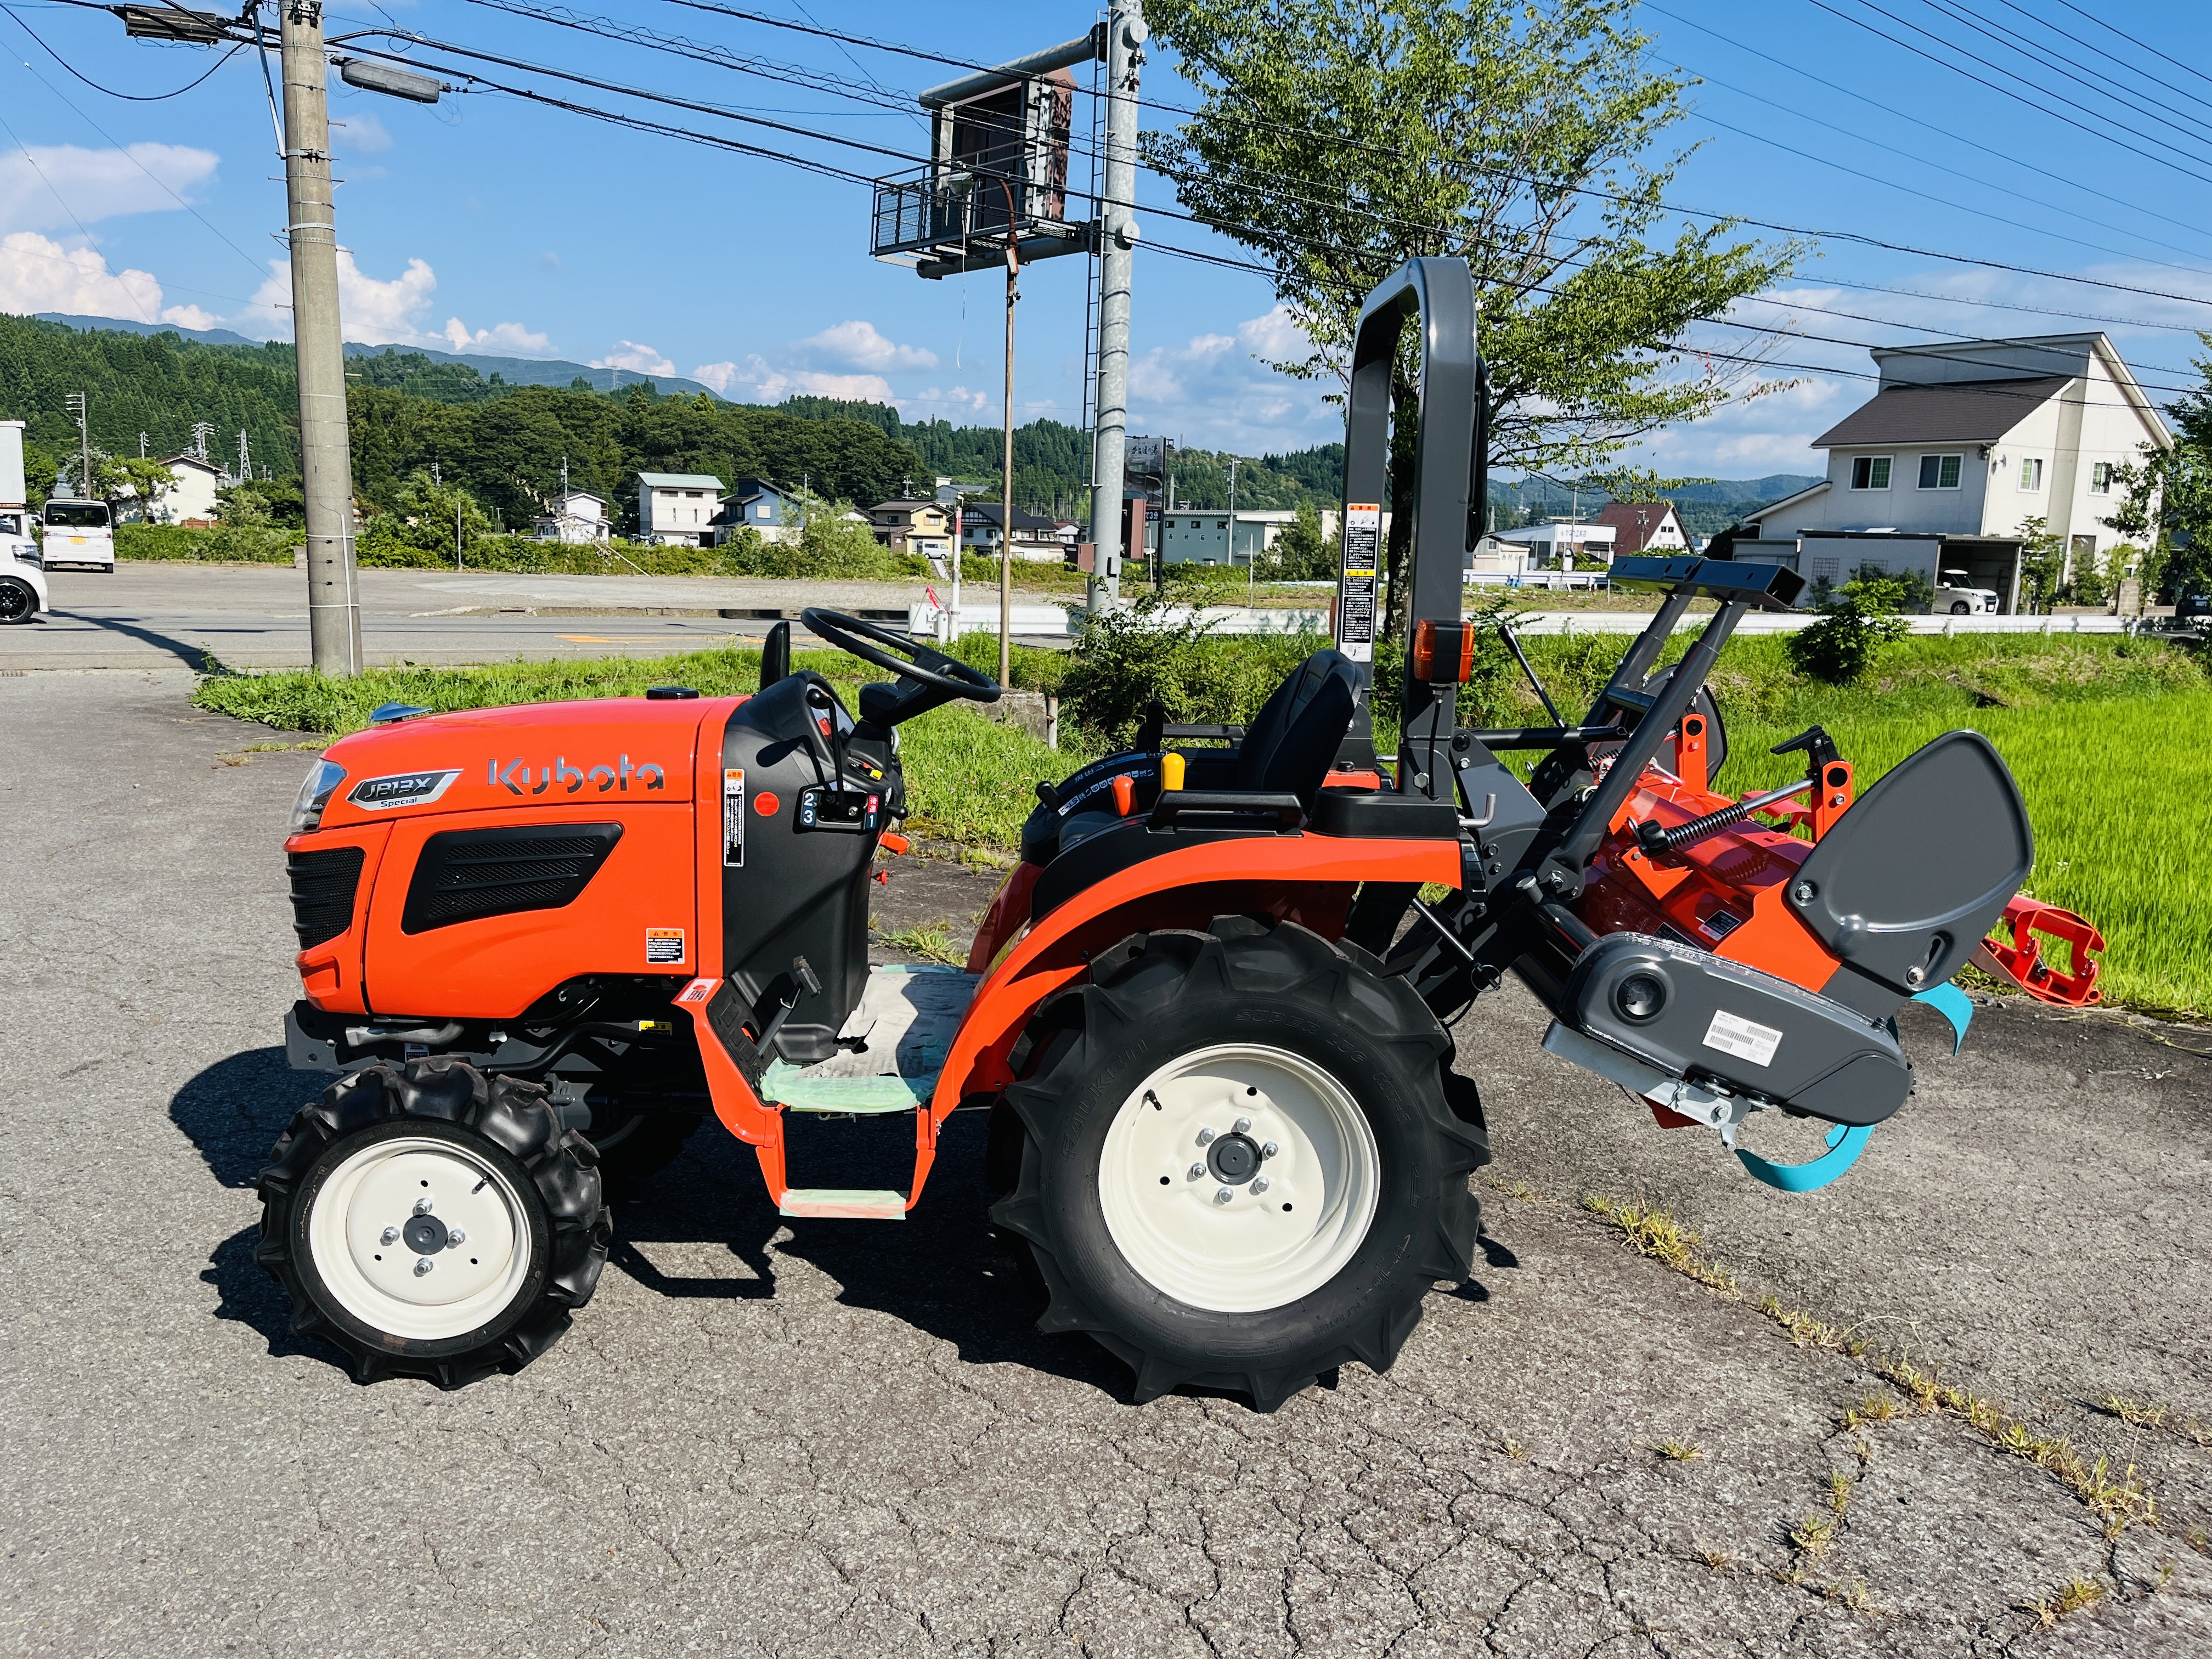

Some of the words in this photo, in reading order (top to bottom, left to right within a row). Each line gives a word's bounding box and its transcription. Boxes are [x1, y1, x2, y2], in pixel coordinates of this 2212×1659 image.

[488, 754, 664, 795] Kubota
[364, 777, 432, 799] JB13X
[380, 797, 417, 807] Special
[804, 793, 814, 806] 2
[803, 810, 813, 823] 3
[870, 815, 874, 827] 1
[1234, 1006, 1323, 1039] SUPER
